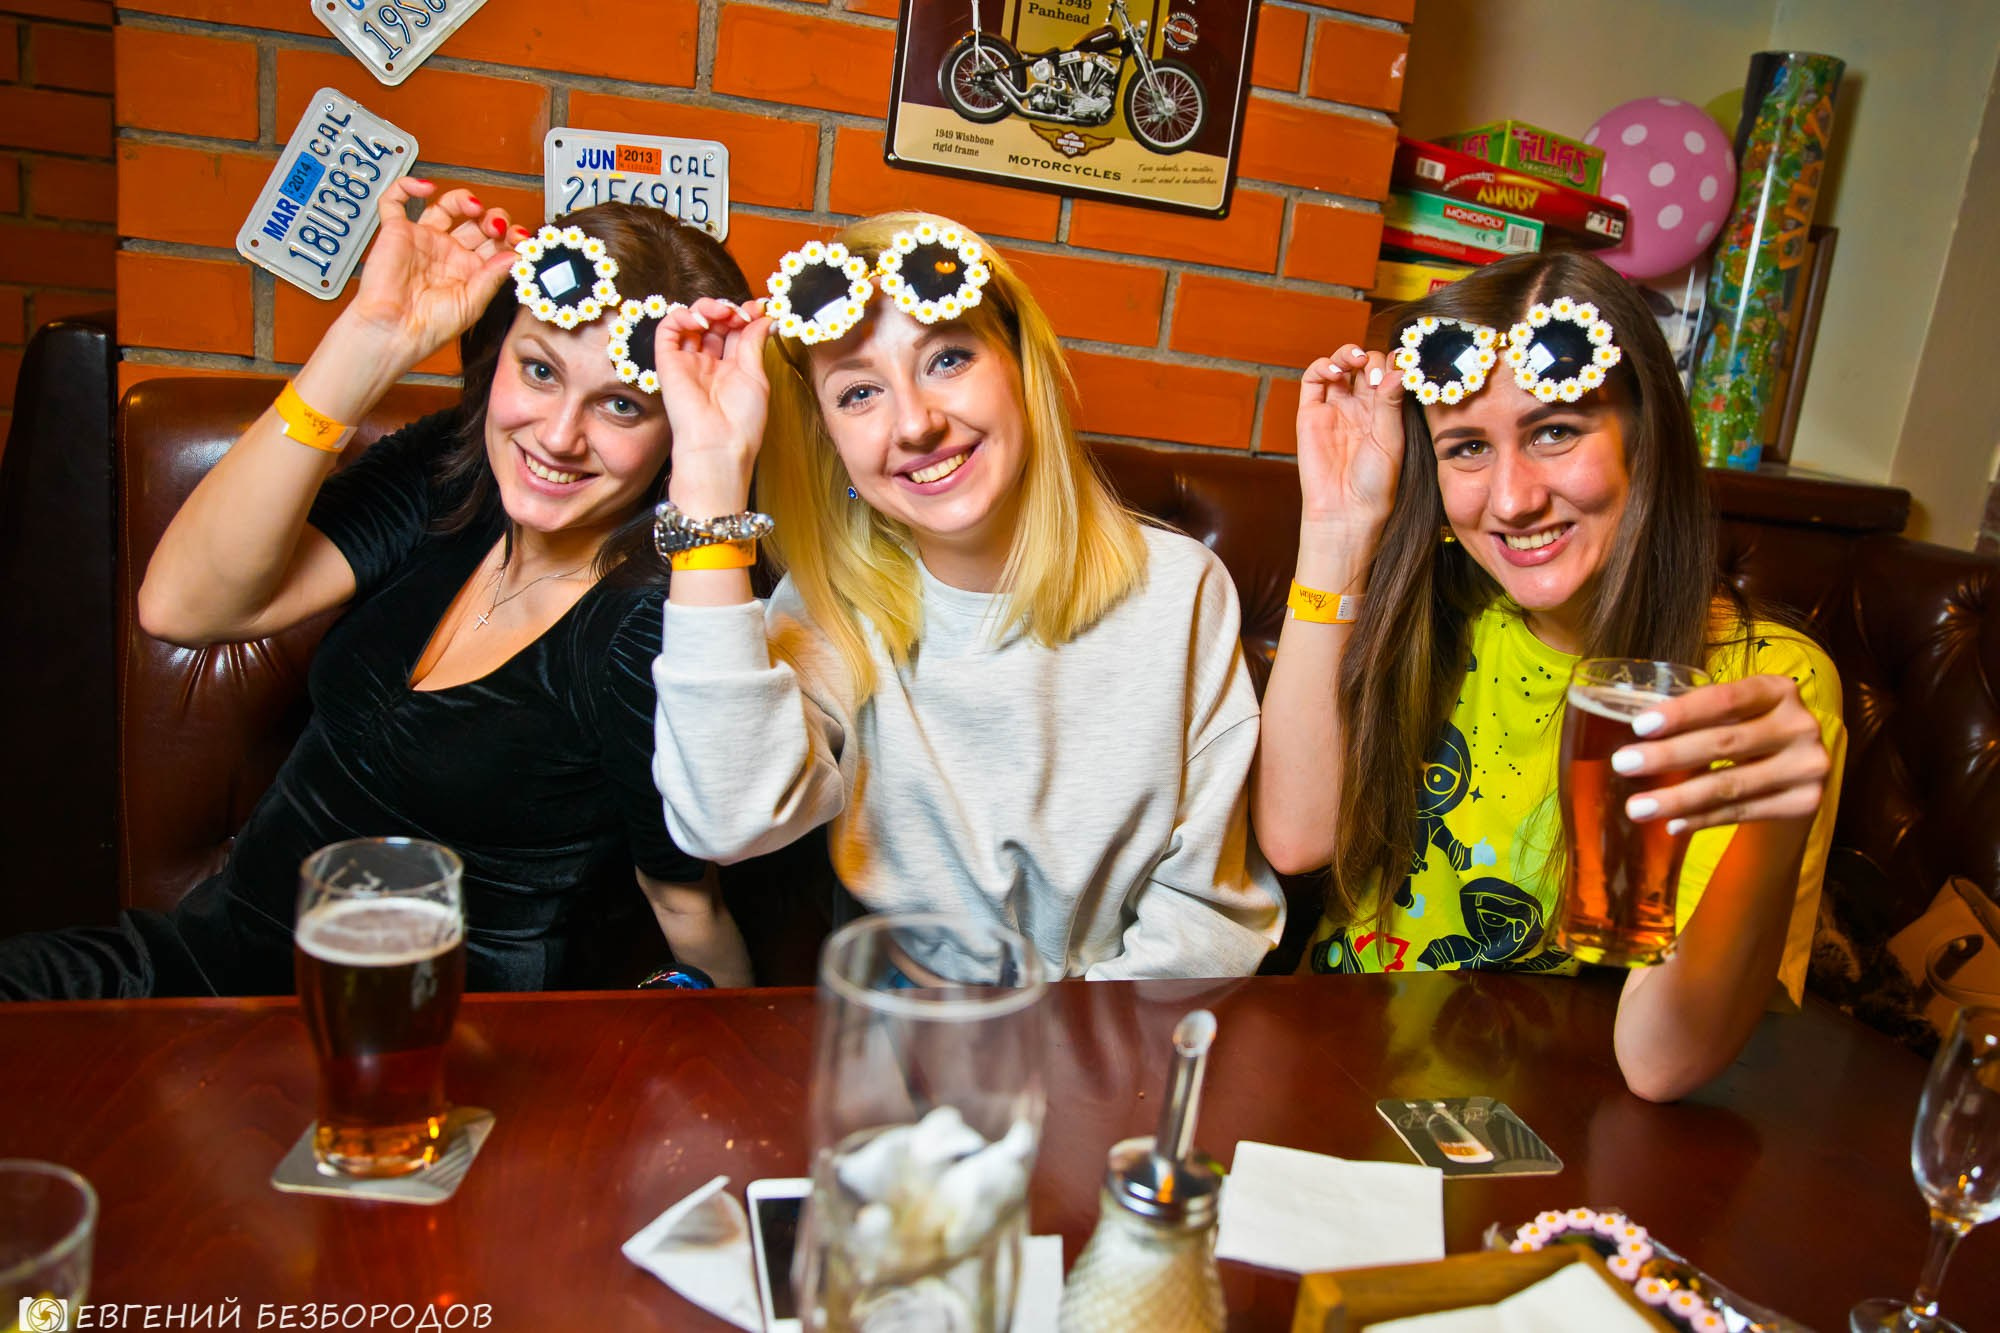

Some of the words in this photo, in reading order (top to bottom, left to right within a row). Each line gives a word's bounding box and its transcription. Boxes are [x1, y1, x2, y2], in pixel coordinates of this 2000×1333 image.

[1028, 2, 1090, 25] Panhead
[933, 141, 953, 154] rigid
[955, 145, 980, 157] frame
[935, 128, 954, 140] 1949
[955, 131, 995, 146] Wishbone
[576, 148, 615, 170] JUN
[624, 149, 653, 164] 2013
[670, 155, 715, 179] CAL
[1008, 154, 1121, 181] MOTORCYCLES
[262, 197, 300, 242] MAR
[289, 162, 313, 193] 2014
[309, 113, 352, 157] CAL
[289, 132, 394, 277] 18U3834
[1446, 207, 1505, 230] MONOPOLY
